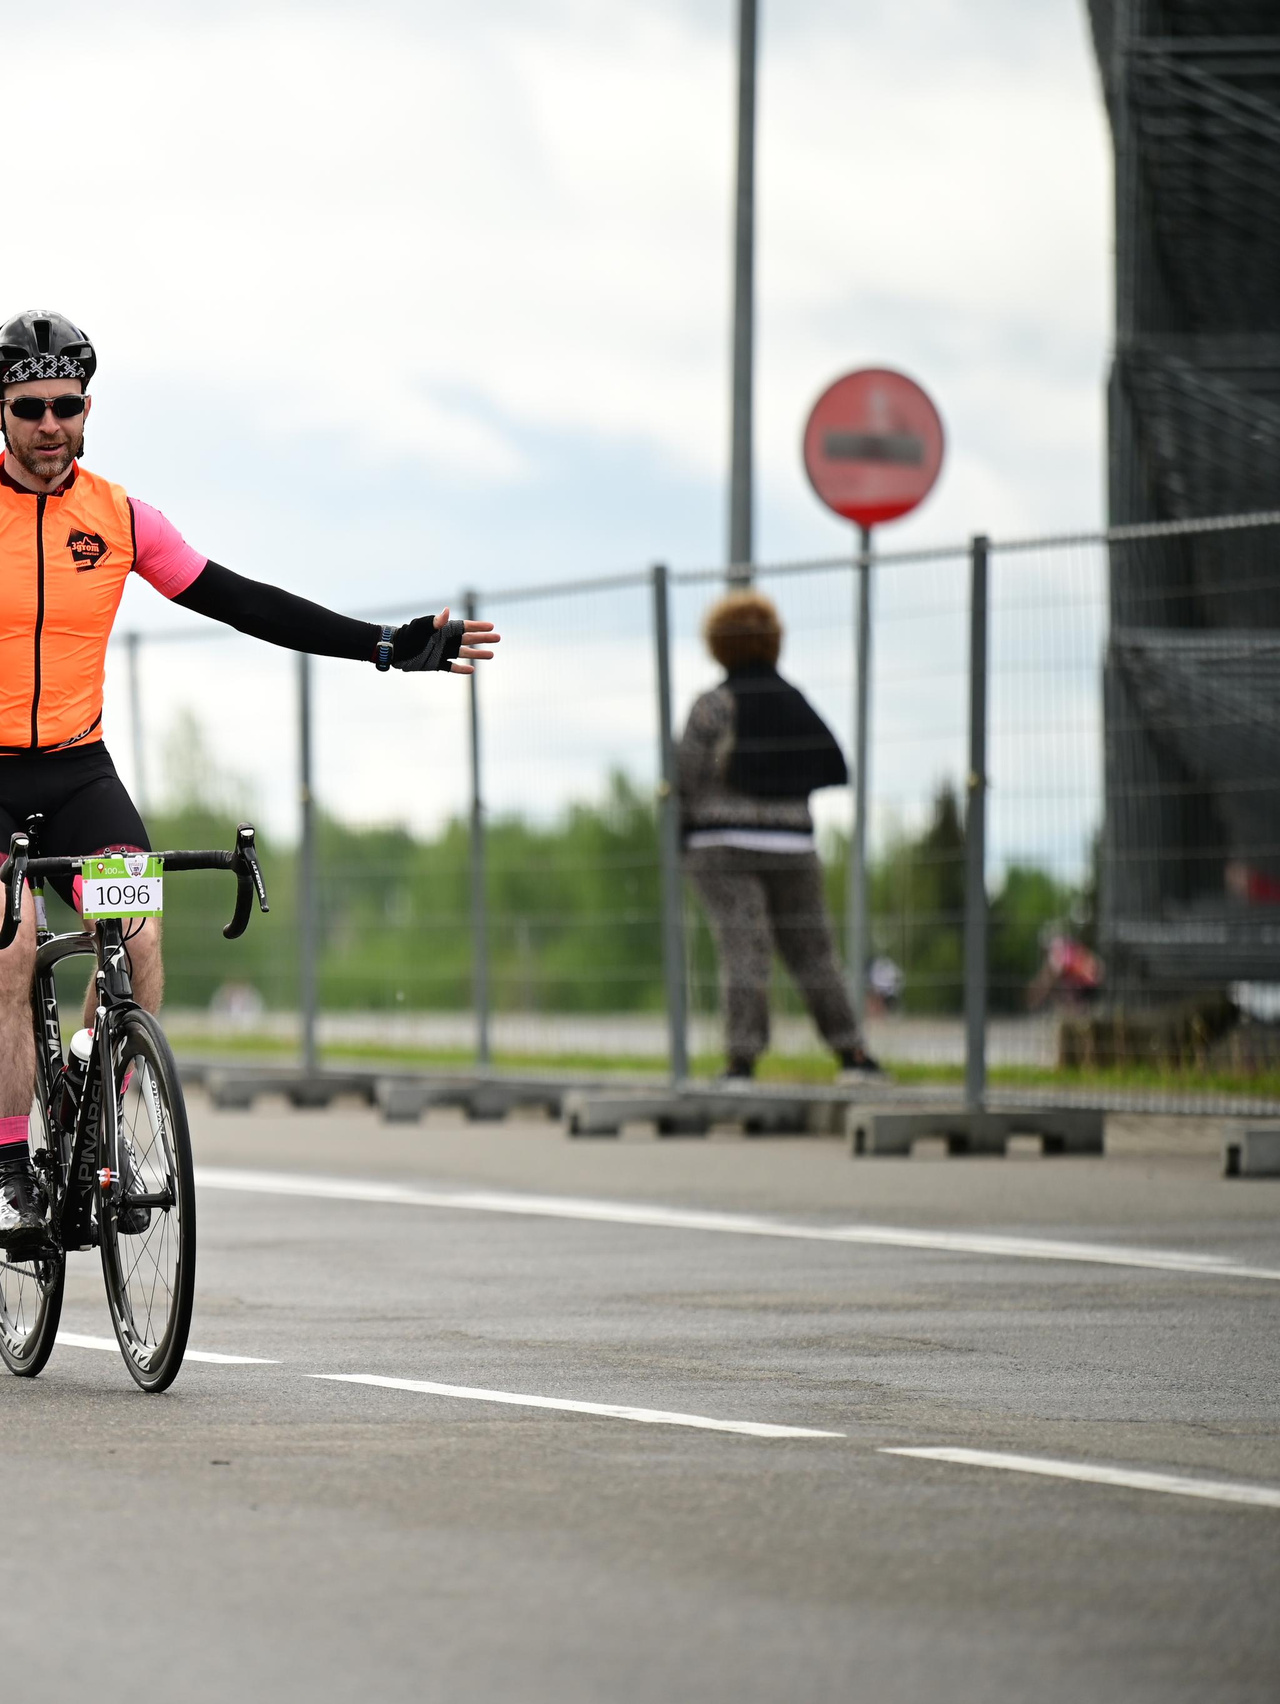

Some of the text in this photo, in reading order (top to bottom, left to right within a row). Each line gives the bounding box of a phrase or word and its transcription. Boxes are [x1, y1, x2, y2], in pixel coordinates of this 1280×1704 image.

[14, 869, 23, 909] ULTEGRA
[96, 885, 150, 905] 1096
[250, 860, 266, 899] ULTEGRA
